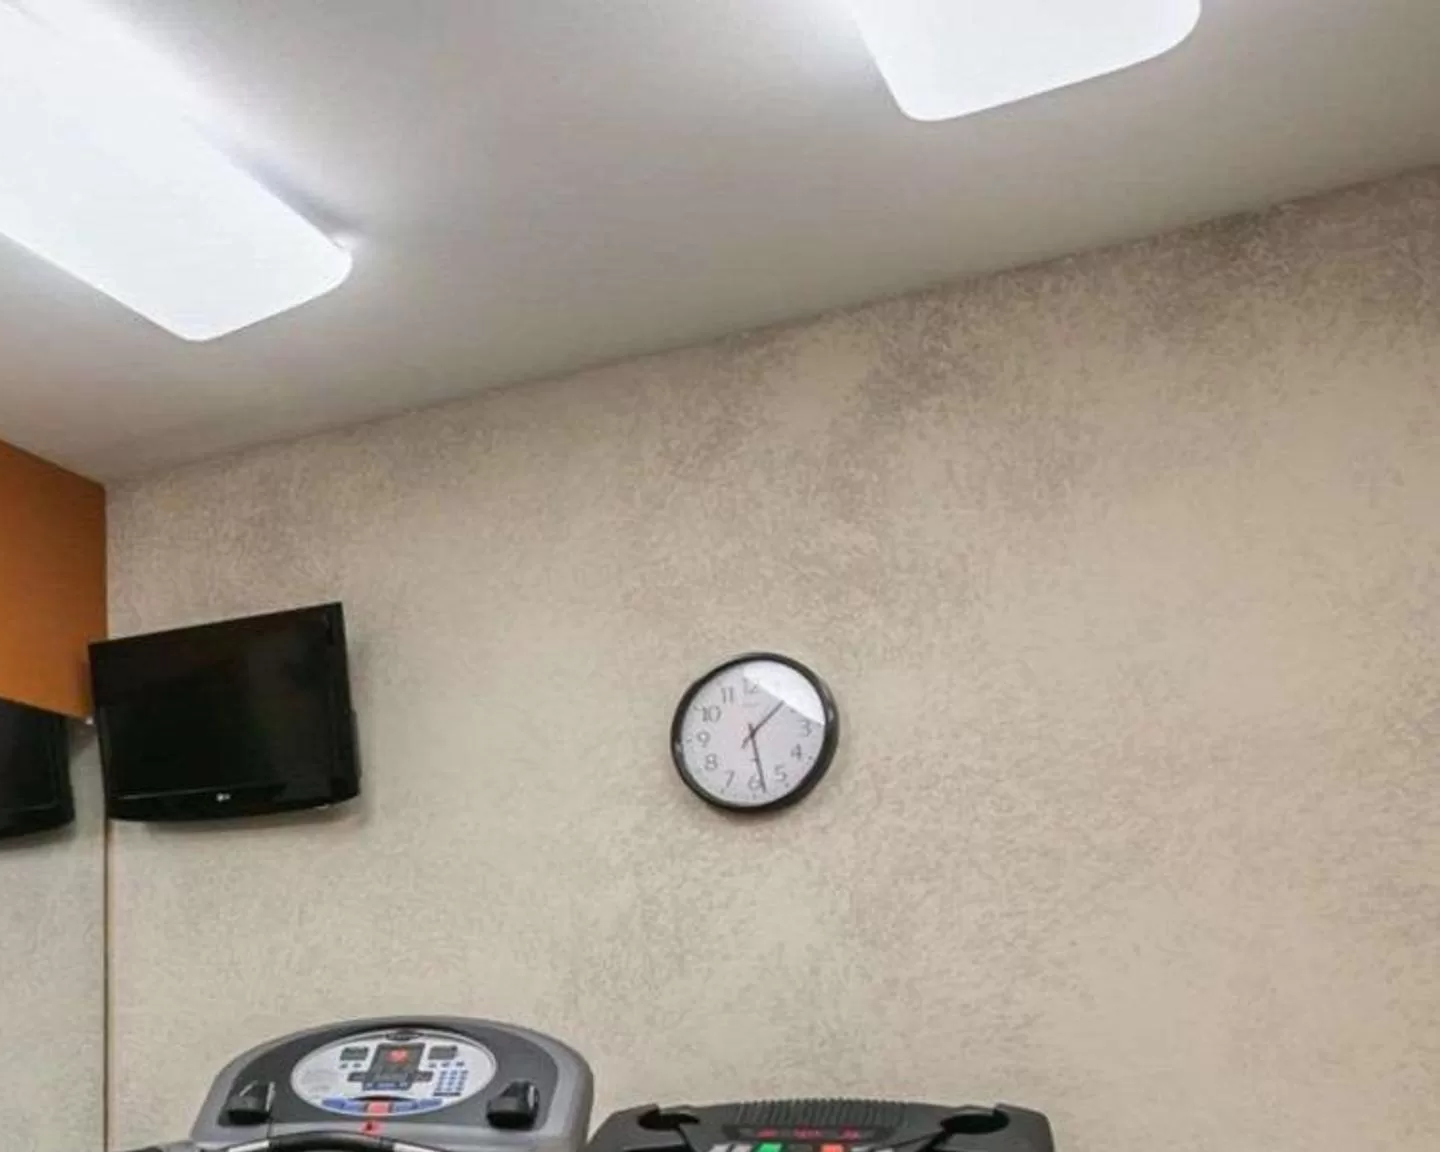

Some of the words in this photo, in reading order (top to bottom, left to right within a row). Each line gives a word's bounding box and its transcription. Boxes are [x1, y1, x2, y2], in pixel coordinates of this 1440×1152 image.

[720, 686, 734, 704] 11
[701, 705, 721, 722] 10
[799, 719, 812, 737] 3
[696, 731, 710, 748] 9
[790, 744, 802, 760] 4
[704, 753, 718, 771] 8
[723, 770, 735, 788] 7
[773, 764, 788, 782] 5
[747, 774, 760, 791] 6
